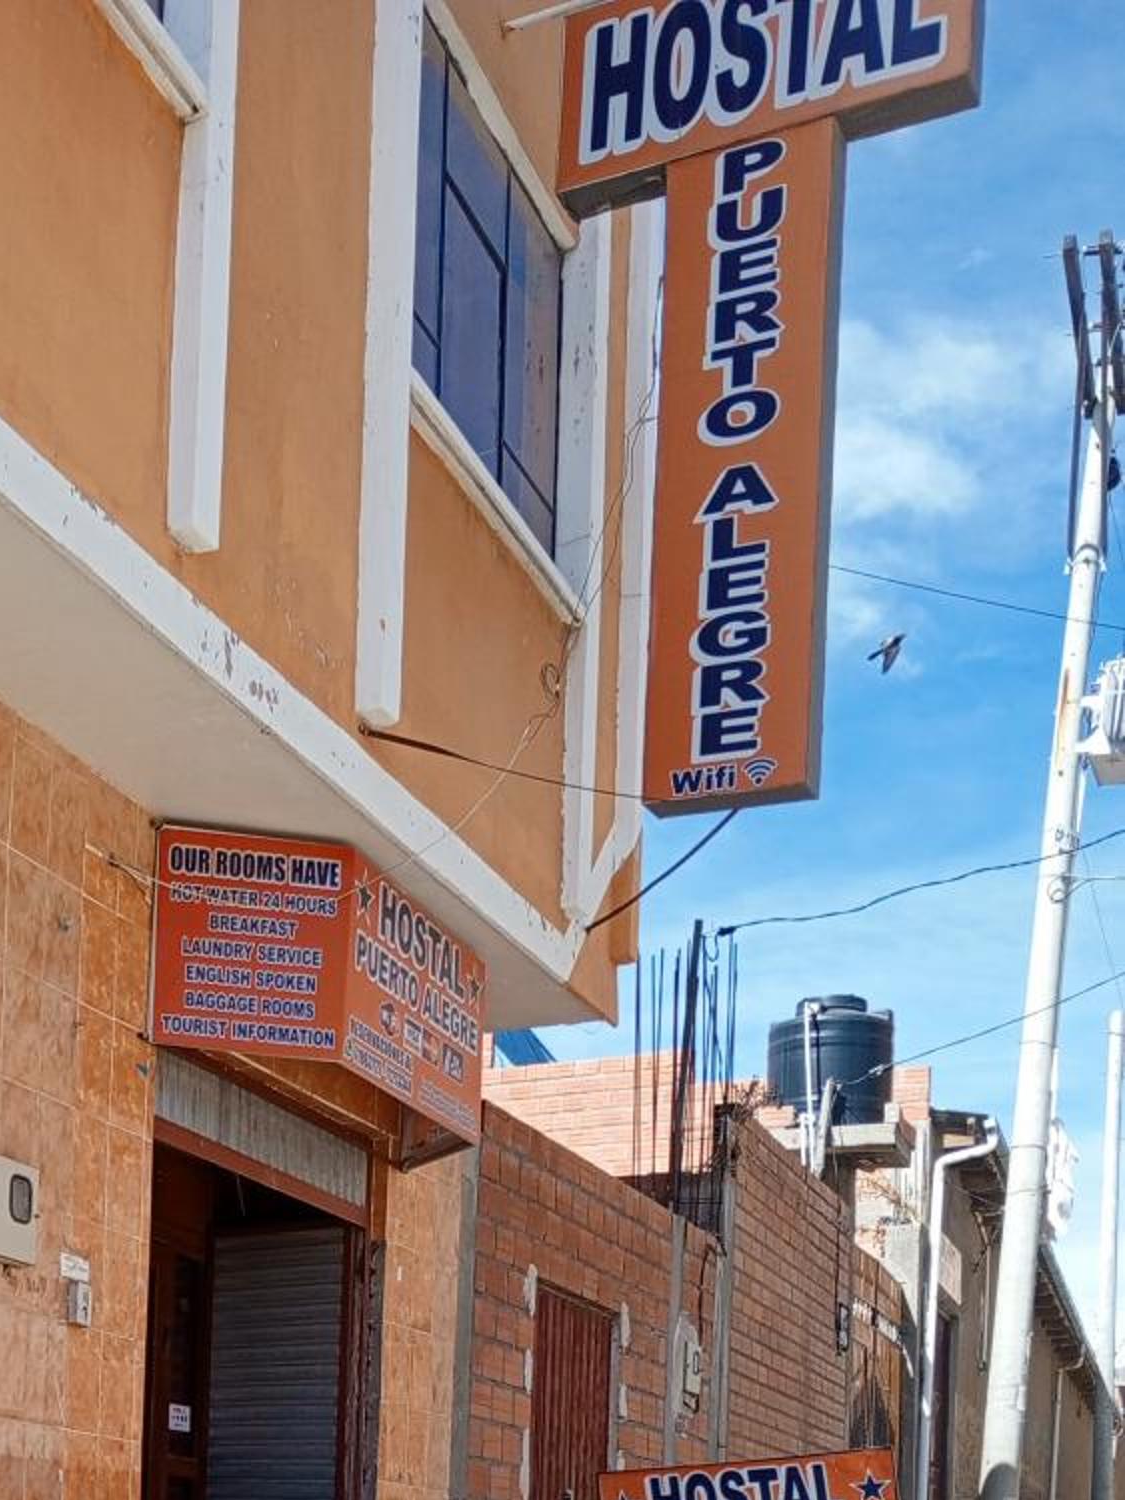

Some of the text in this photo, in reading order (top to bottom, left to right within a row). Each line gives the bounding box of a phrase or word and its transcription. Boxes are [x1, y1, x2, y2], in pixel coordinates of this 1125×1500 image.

[588, 0, 943, 154] HOSTAL
[706, 141, 785, 440] PUERTO
[696, 465, 777, 757] ALEGRE
[672, 764, 736, 795] Wifi
[171, 846, 340, 888] OUR ROOMS HAVE
[171, 885, 337, 915] HOT WATER 24 HOURS
[209, 915, 297, 938] BREAKFAST
[182, 939, 322, 966] LAUNDRY SERVICE
[380, 885, 465, 1000] HOSTAL
[186, 966, 316, 992] ENGLISH SPOKEN
[185, 992, 315, 1019] BAGGAGE ROOMS
[356, 934, 418, 1008] PUERTO
[423, 984, 478, 1056] ALEGRE
[162, 1016, 334, 1047] TOURIST INFORMATION
